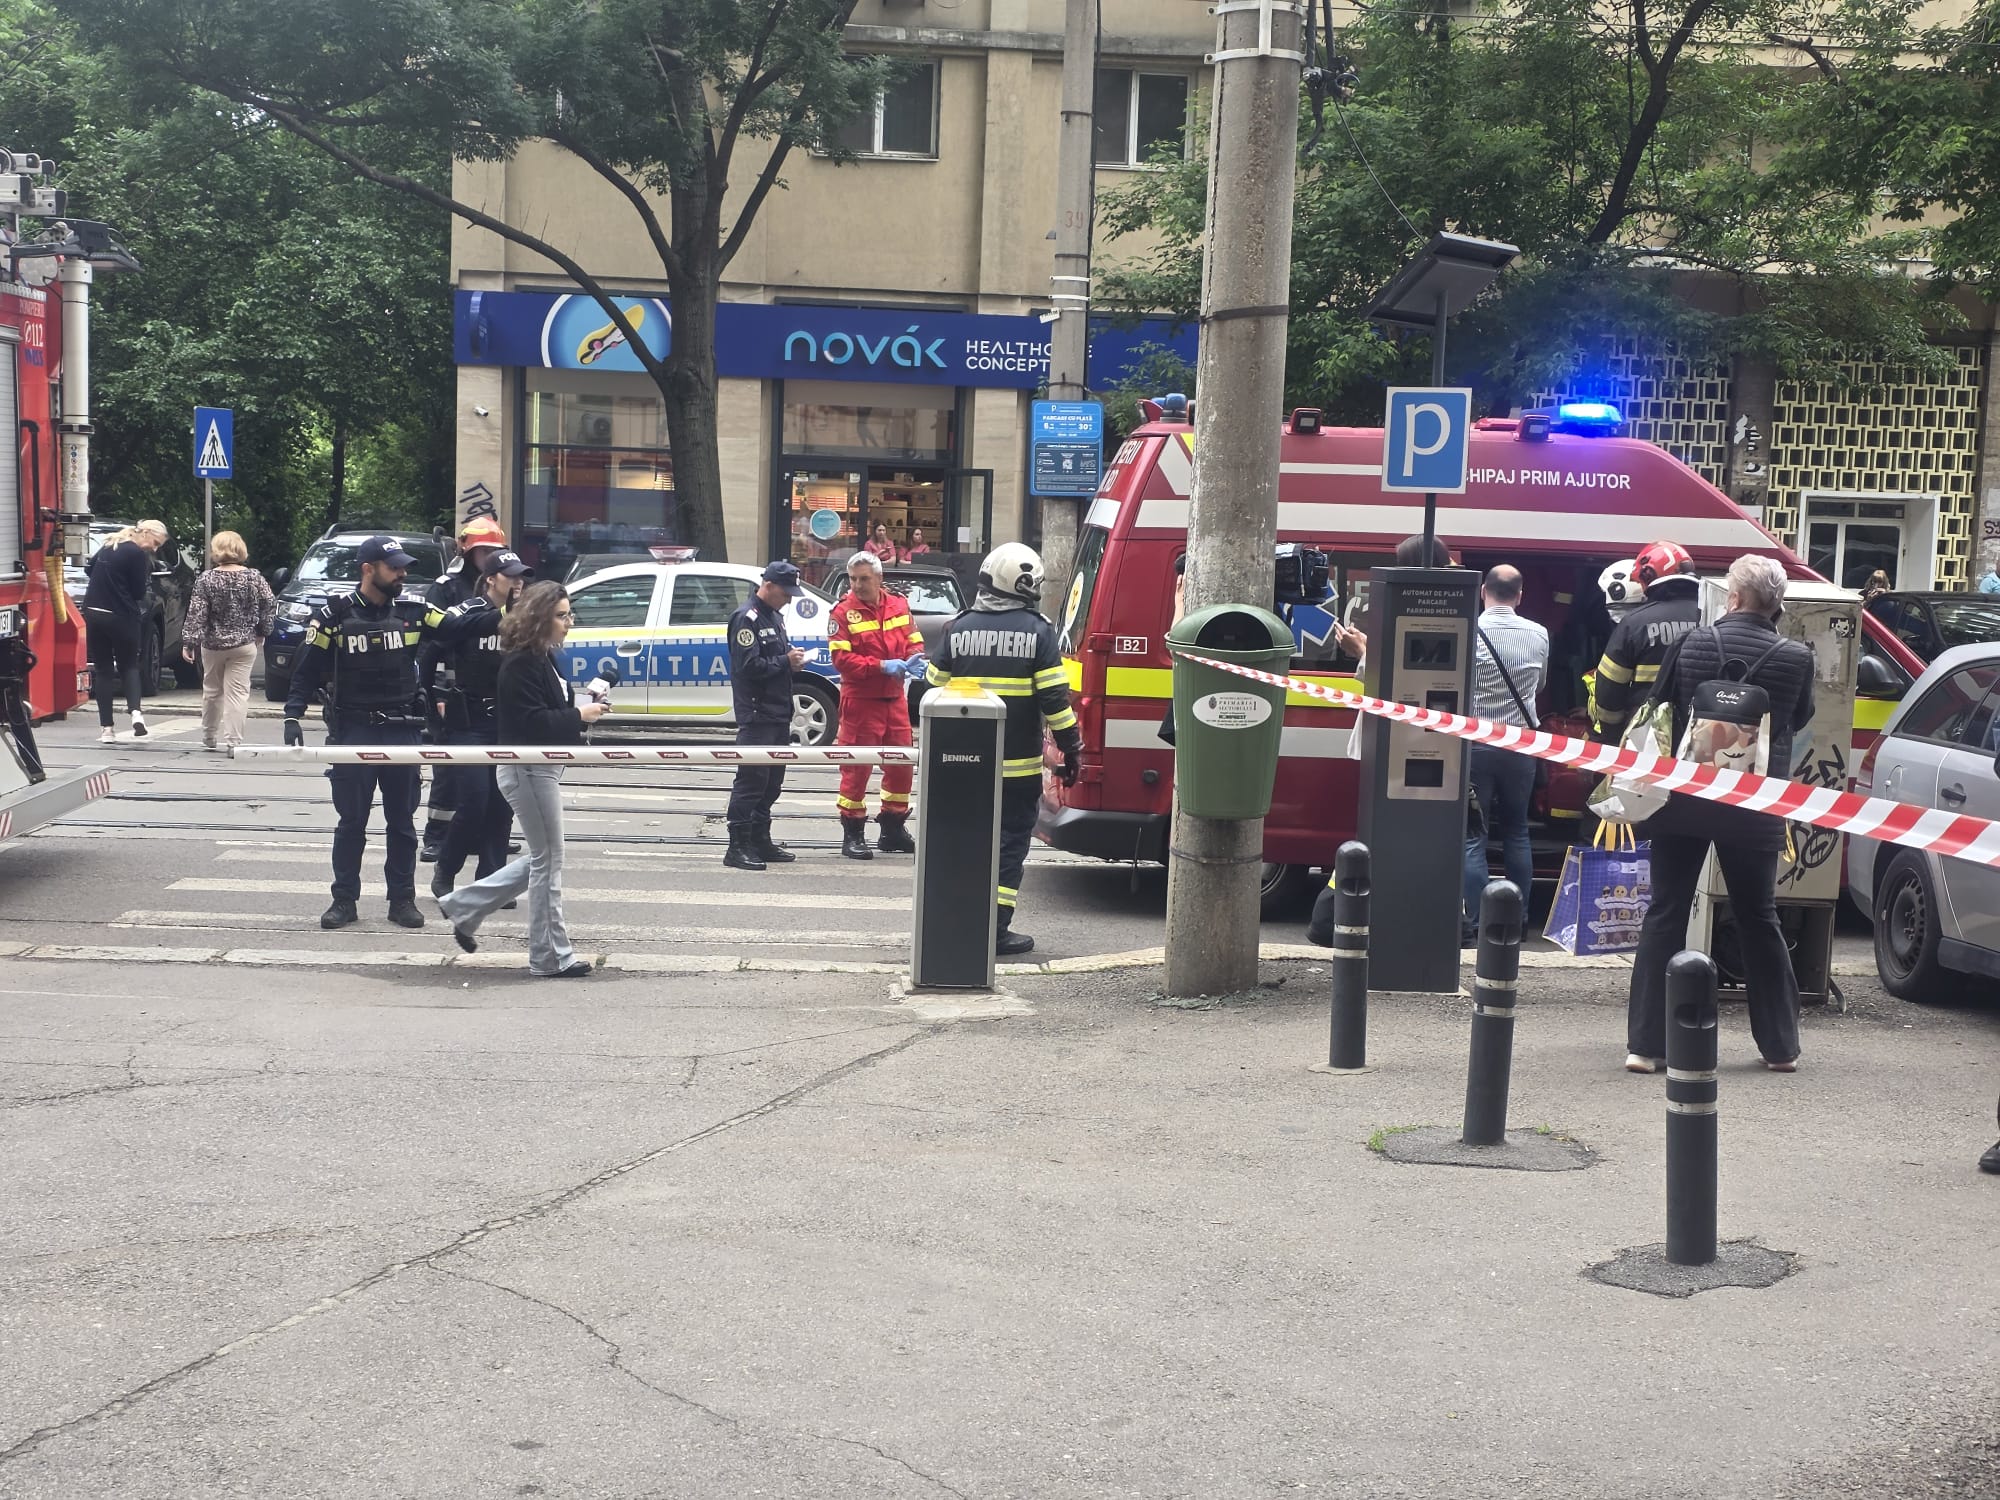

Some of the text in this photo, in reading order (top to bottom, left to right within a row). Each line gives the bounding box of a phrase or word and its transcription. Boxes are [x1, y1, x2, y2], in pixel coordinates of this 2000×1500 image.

[32, 323, 44, 347] 112
[784, 325, 948, 367] novák
[1520, 469, 1561, 487] PRIM
[1564, 471, 1632, 490] AJUTOR
[1123, 639, 1141, 652] B2
